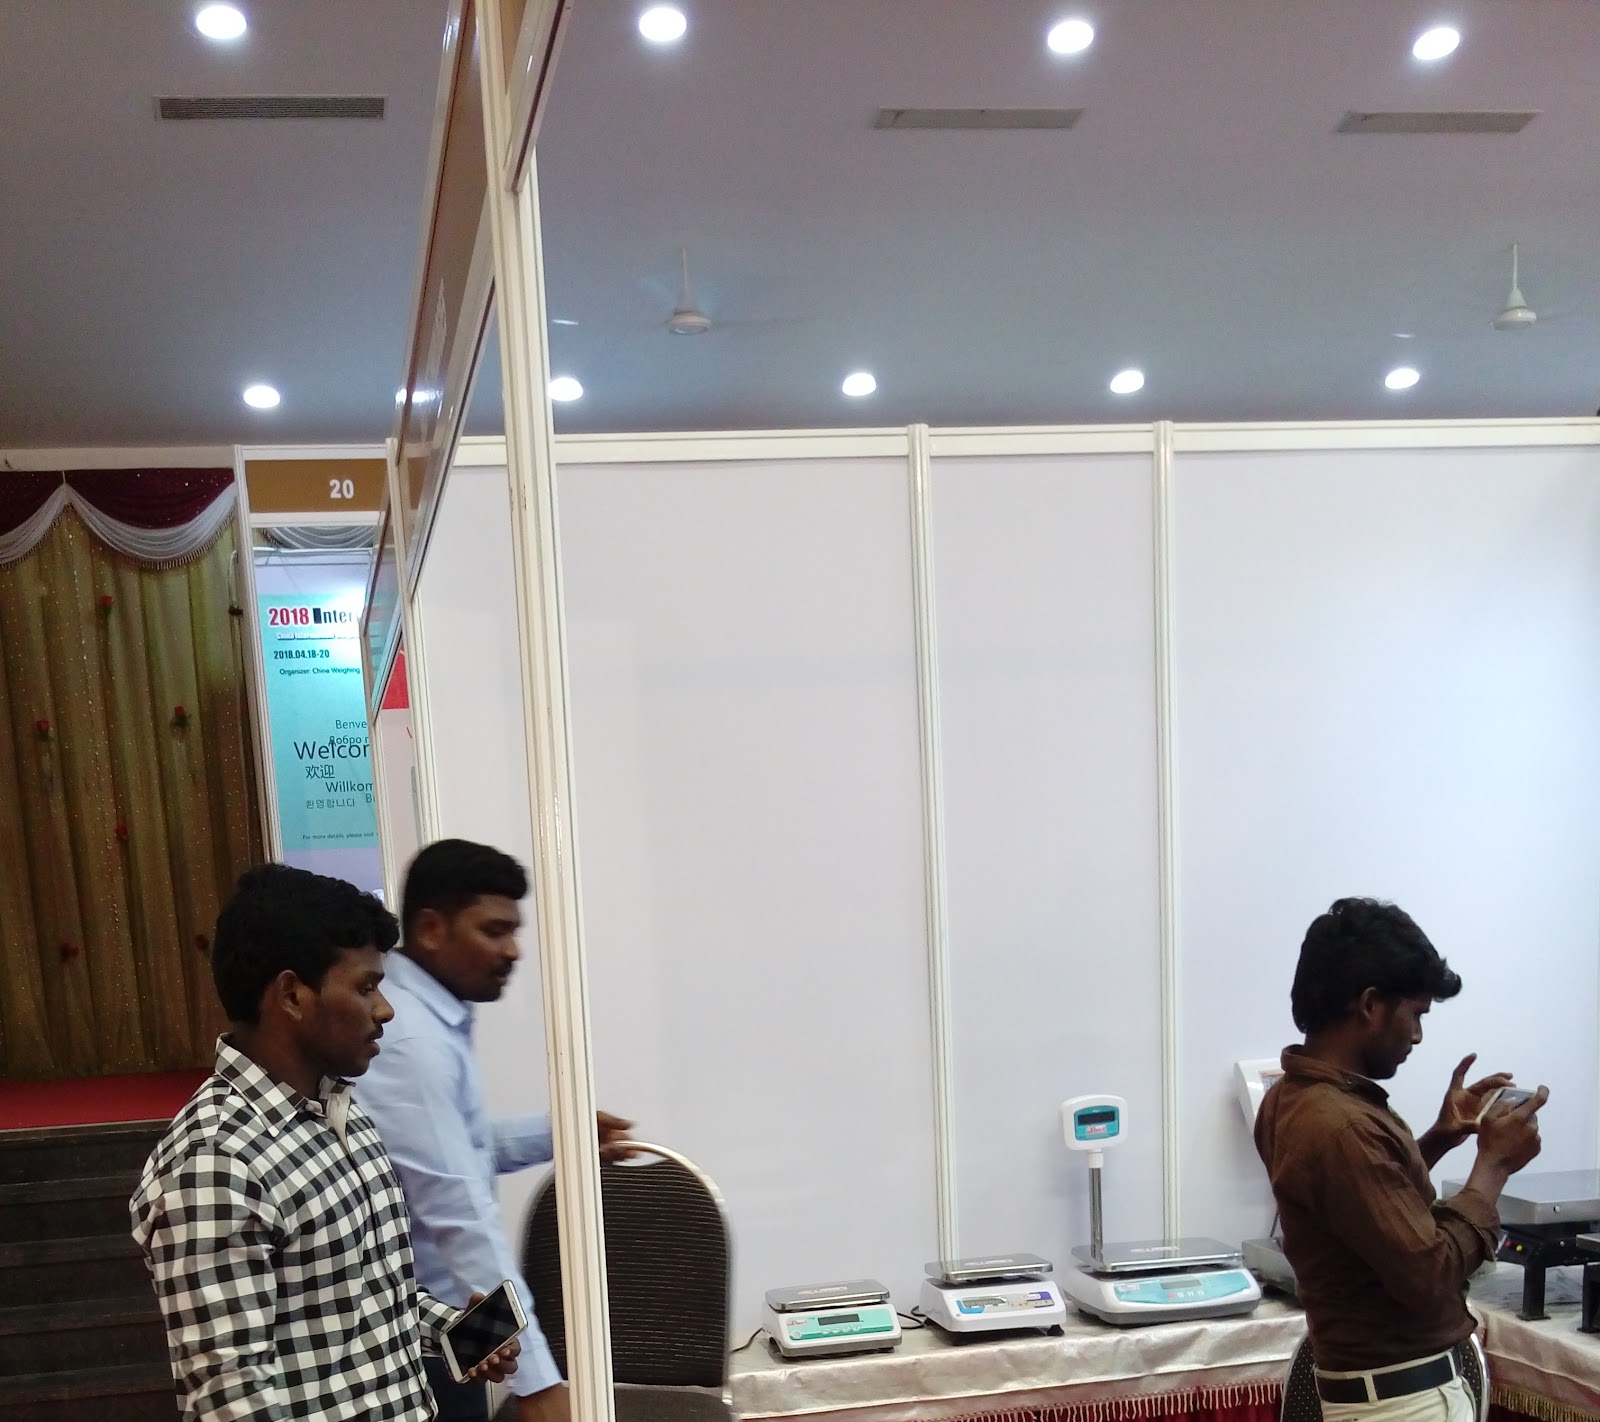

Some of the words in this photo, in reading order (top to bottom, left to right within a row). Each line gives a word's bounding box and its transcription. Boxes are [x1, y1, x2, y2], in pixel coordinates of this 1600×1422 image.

[329, 479, 354, 499] 20
[268, 607, 310, 626] 2018
[273, 649, 330, 660] 2018.04.18-20
[312, 667, 330, 675] China
[331, 667, 360, 675] Weighing
[305, 764, 336, 780] 欢迎
